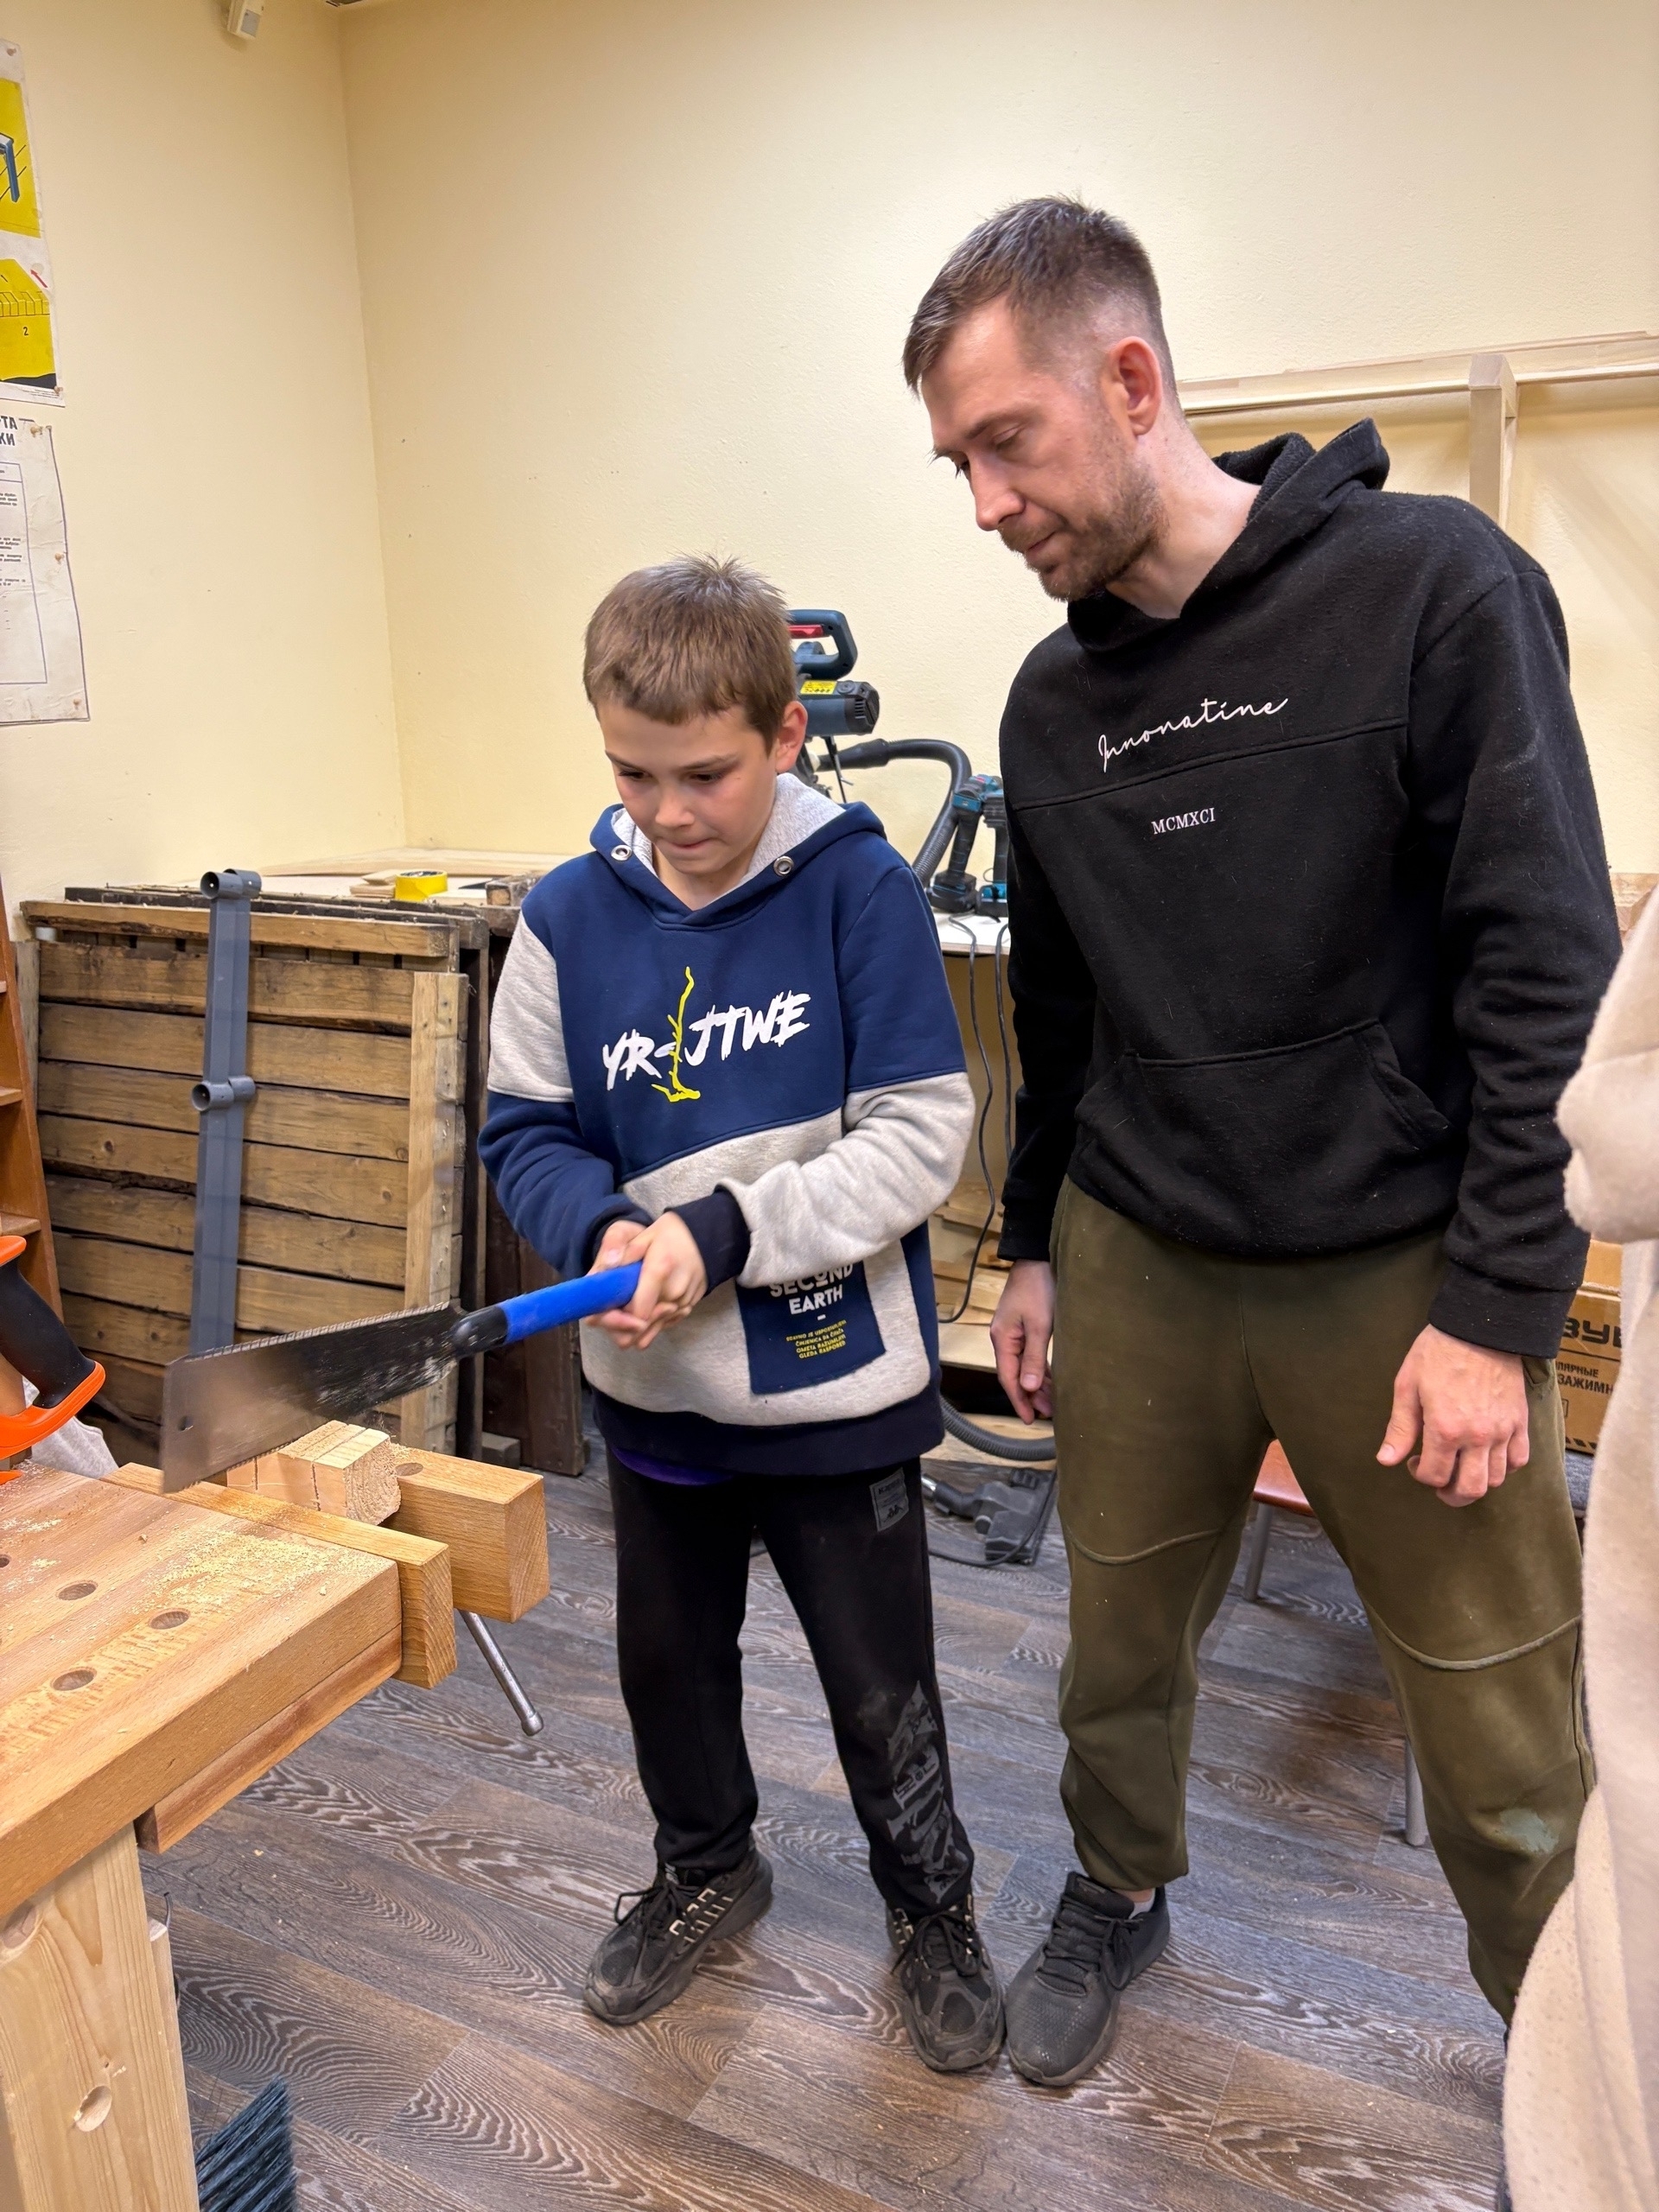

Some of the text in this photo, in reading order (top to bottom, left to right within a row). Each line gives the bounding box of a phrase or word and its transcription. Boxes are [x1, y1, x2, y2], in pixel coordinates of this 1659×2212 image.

[22, 326, 29, 336] 2
[0, 415, 18, 430] ТА
[1151, 807, 1216, 835] MCMXCI
[769, 1263, 854, 1298] SECOND
[788, 1284, 843, 1314] EARTH
